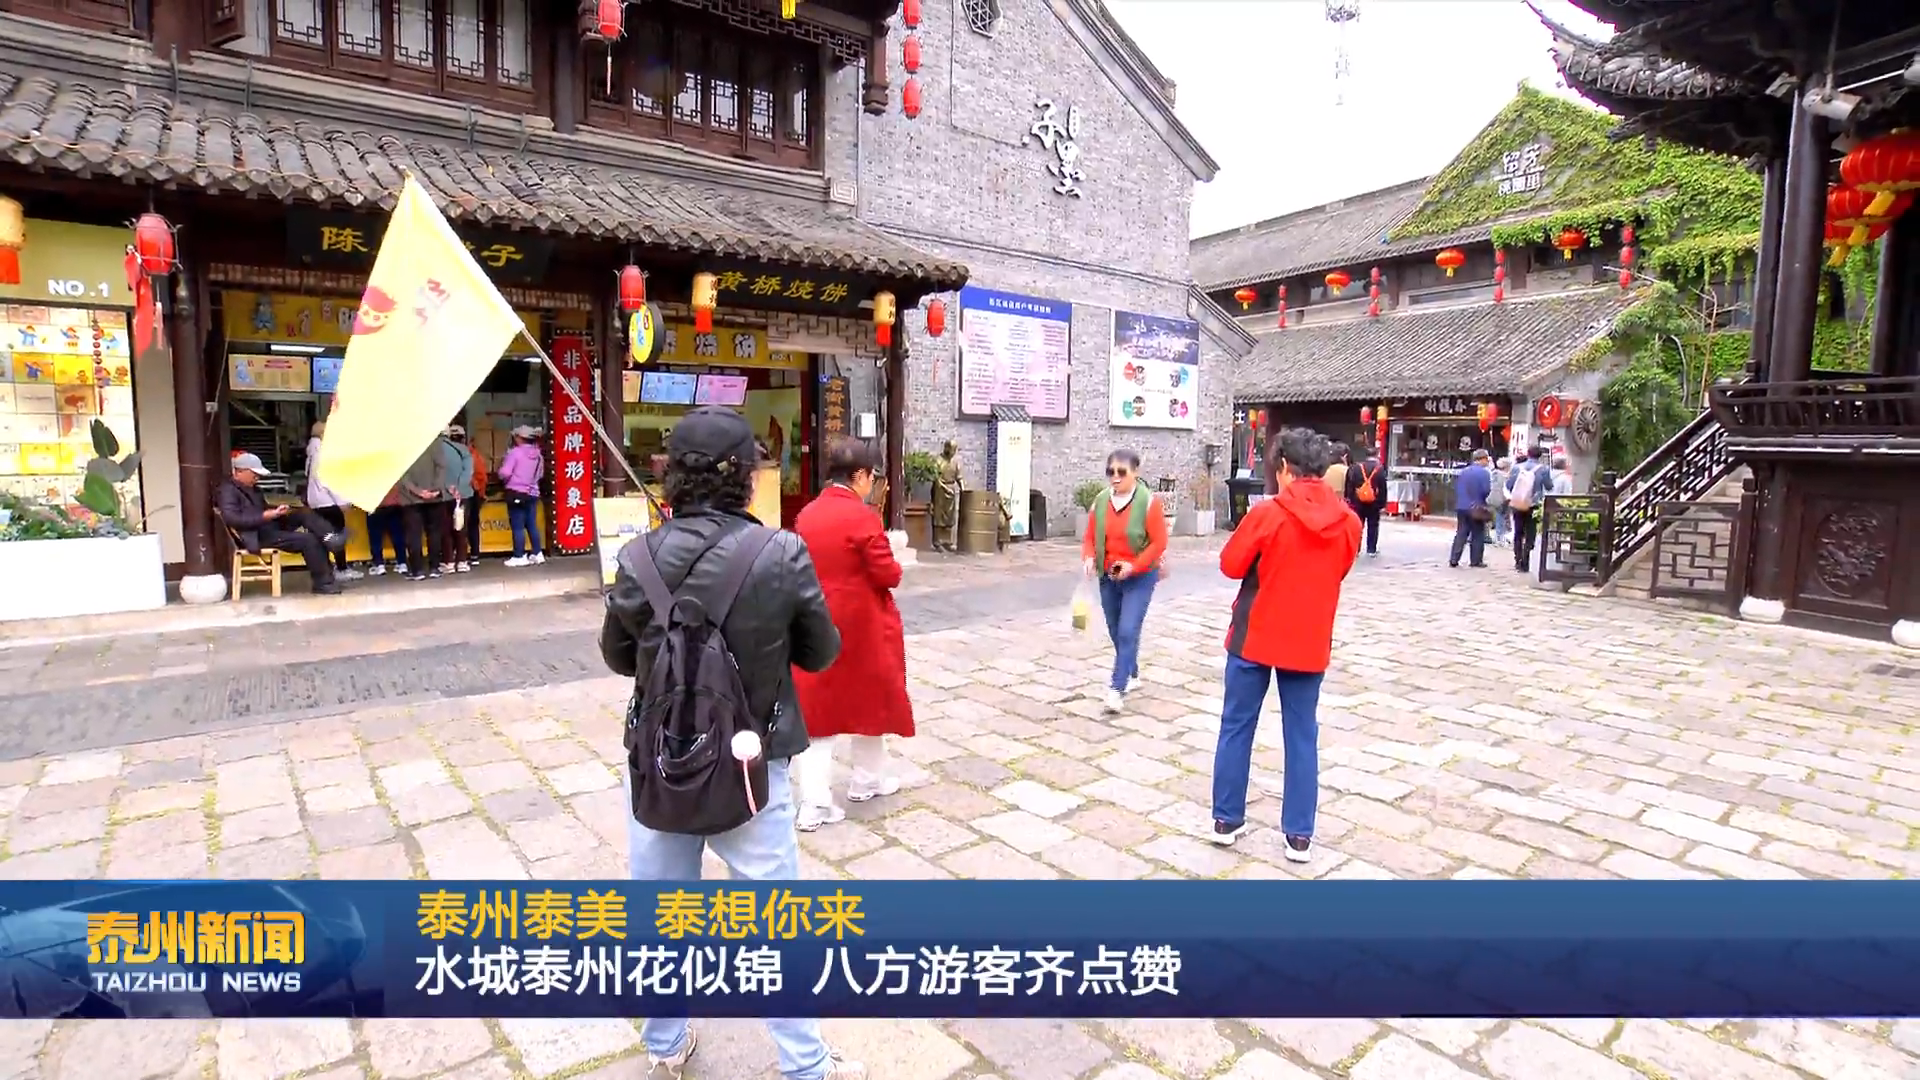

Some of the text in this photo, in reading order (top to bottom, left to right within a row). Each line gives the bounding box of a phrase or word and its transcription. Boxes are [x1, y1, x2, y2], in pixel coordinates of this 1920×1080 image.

[48, 279, 110, 298] NO.1
[718, 271, 848, 303] 黄桥烧饼
